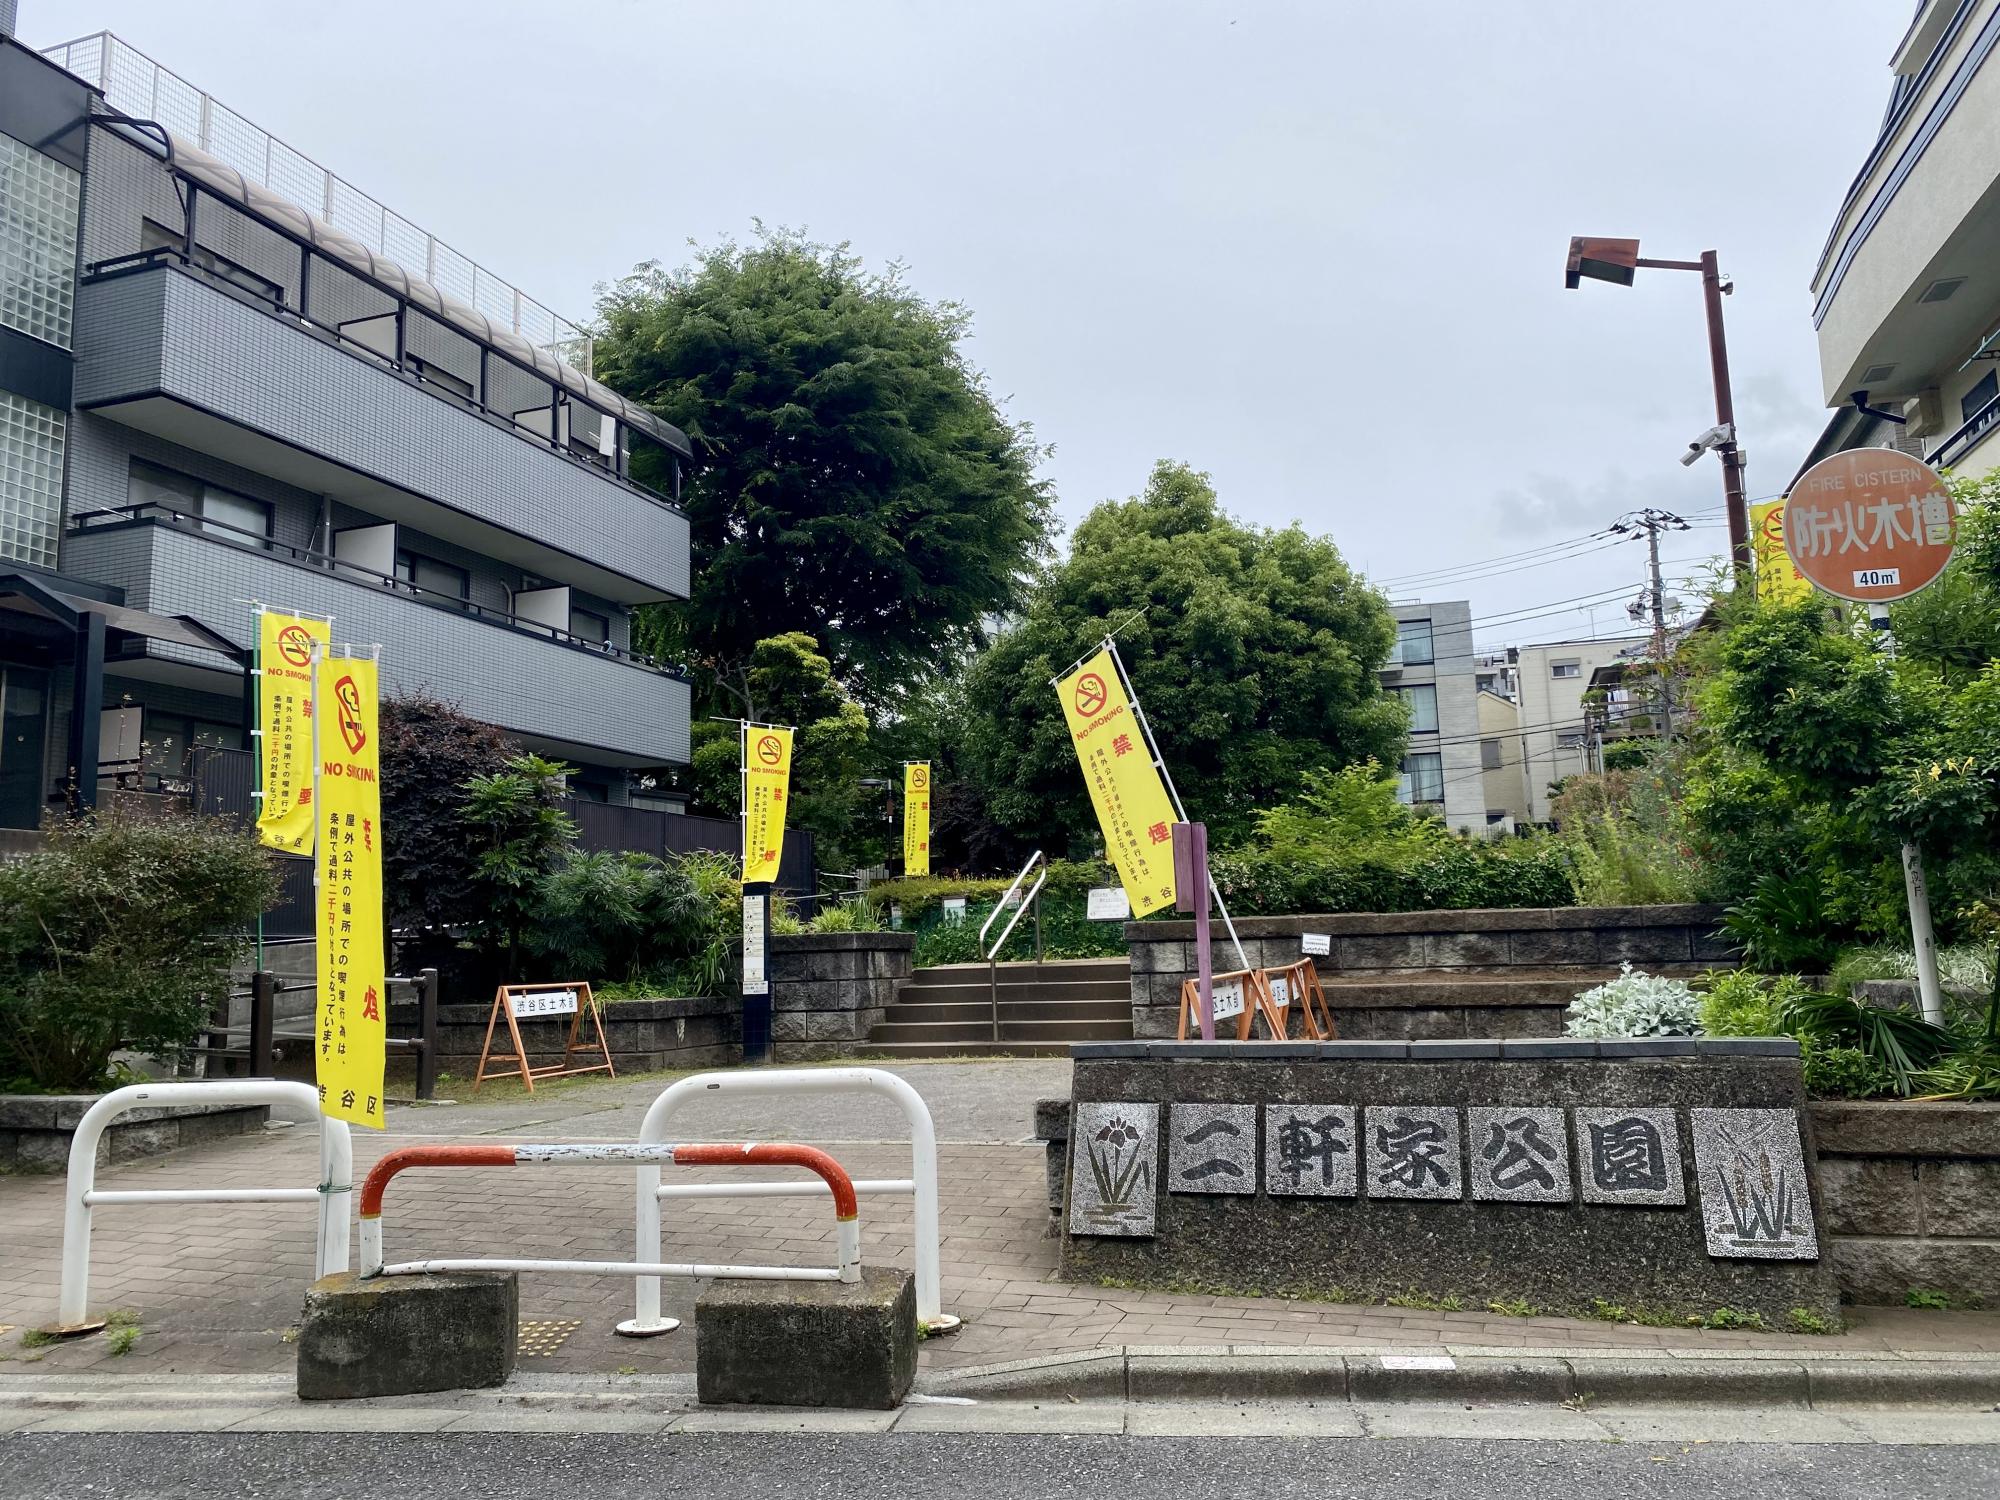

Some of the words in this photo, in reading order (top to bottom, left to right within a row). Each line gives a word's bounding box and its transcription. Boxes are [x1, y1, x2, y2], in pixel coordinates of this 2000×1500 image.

[1809, 475, 1846, 493] FIRE
[1854, 467, 1922, 488] CISTERN
[267, 667, 283, 676] NO
[1075, 729, 1089, 741] NO
[1088, 705, 1124, 733] SMOKING
[325, 761, 344, 777] NO
[762, 768, 787, 776] SMOKING
[1181, 1114, 1669, 1193] 二軒家公園
